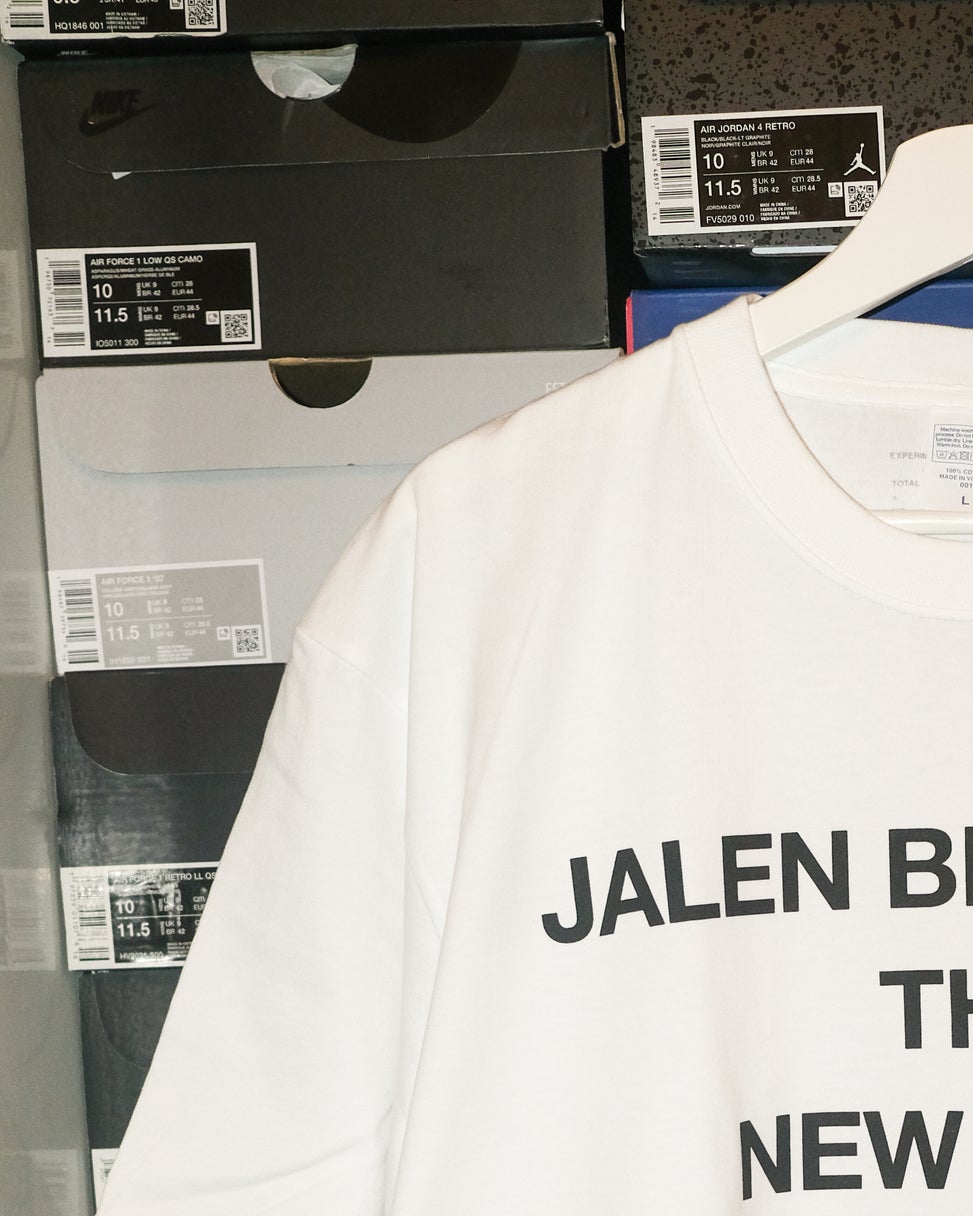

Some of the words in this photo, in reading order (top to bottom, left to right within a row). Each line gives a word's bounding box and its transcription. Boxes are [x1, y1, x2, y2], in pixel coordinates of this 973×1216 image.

[701, 126, 715, 134] AIR
[718, 124, 754, 132] JORDAN
[765, 122, 796, 130] RETRO
[703, 153, 724, 170] 10
[705, 180, 742, 196] 11.5
[706, 215, 738, 224] FV5029
[740, 214, 754, 222] 010
[93, 283, 112, 298] 10
[94, 307, 128, 323] 11.5
[962, 496, 970, 505] L
[117, 576, 144, 584] FORCE
[104, 602, 124, 617] 10
[106, 625, 140, 640] 11.5
[541, 830, 850, 944] JALEN
[116, 900, 134, 914] 10
[118, 922, 150, 937] 11.5
[738, 1110, 964, 1200] NEW
